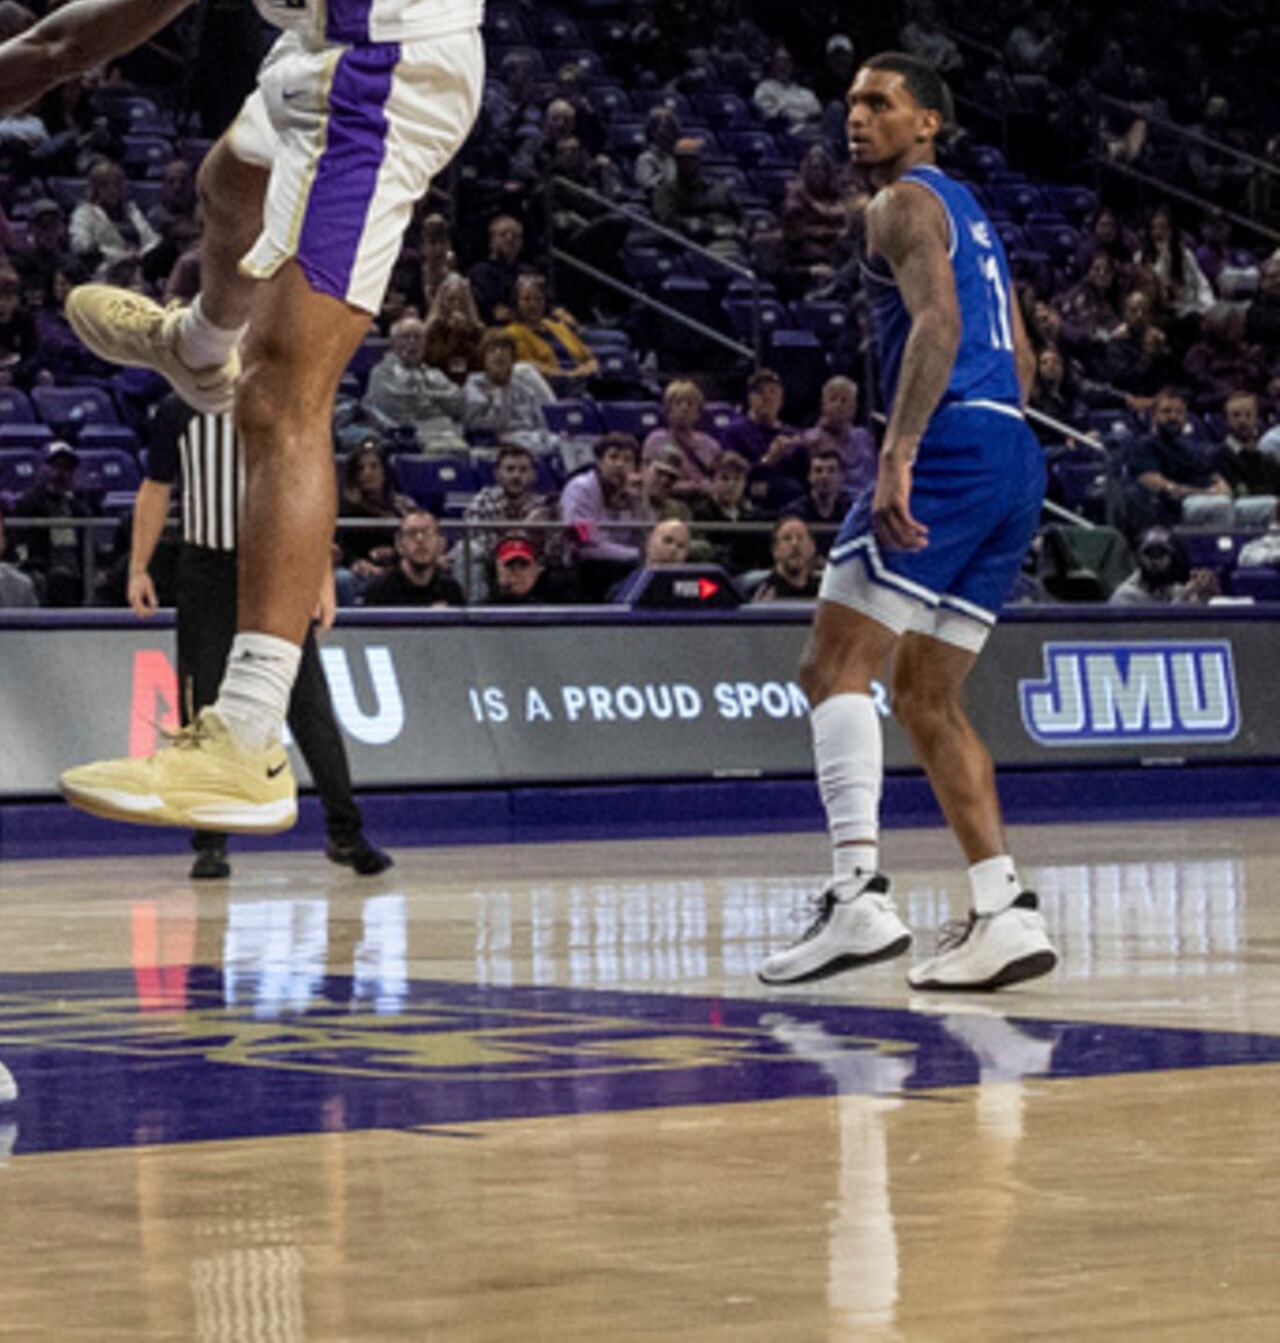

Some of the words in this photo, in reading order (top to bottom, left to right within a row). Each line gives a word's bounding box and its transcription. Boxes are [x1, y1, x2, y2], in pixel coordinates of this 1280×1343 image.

[469, 688, 508, 722] IS
[525, 687, 552, 722] A
[562, 685, 701, 722] PROUD
[713, 681, 890, 719] SPONR
[1023, 646, 1234, 740] JMU
